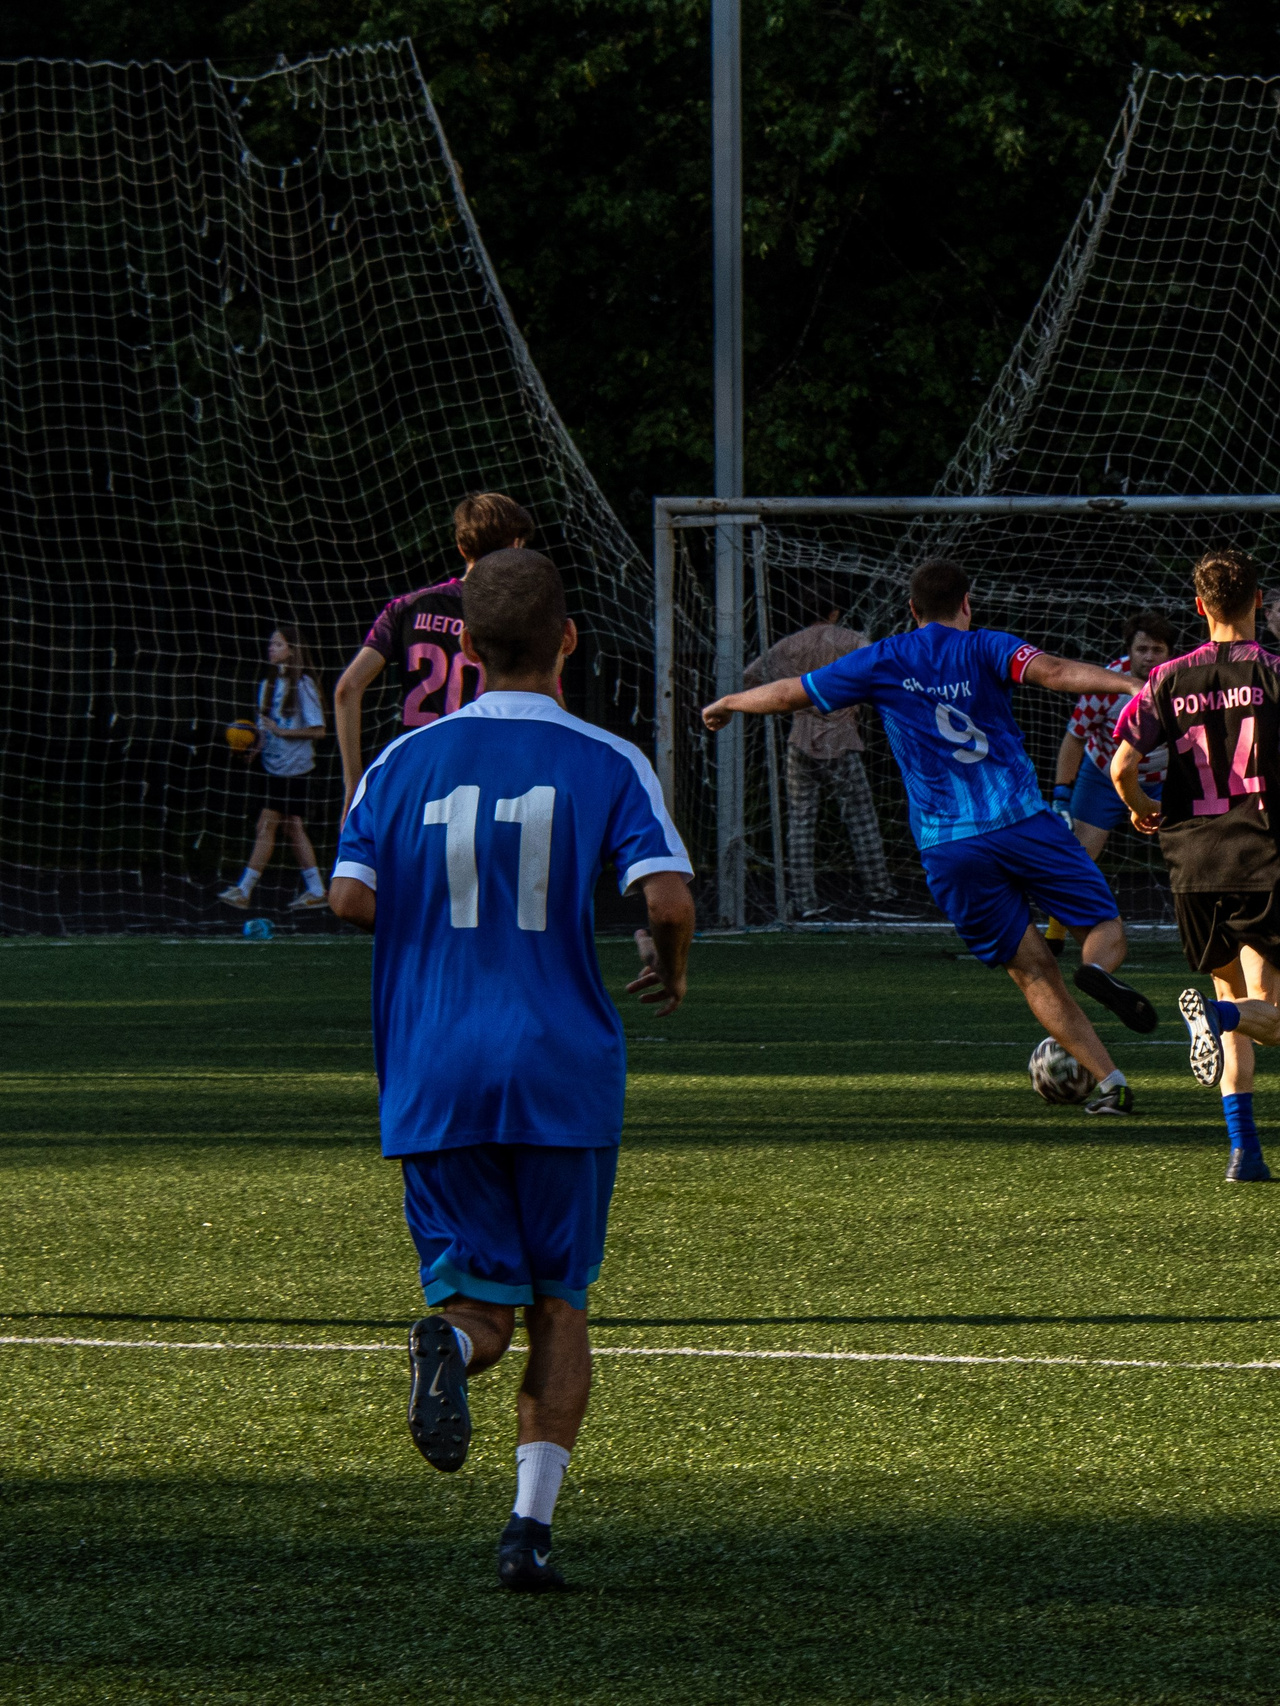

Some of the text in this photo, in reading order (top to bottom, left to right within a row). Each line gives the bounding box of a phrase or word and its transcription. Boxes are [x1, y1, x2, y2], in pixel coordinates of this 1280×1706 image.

[404, 642, 487, 727] 20
[1173, 686, 1264, 716] РОМАНОВ
[935, 702, 989, 763] 9
[1175, 716, 1267, 816] 14
[423, 784, 556, 931] 11
